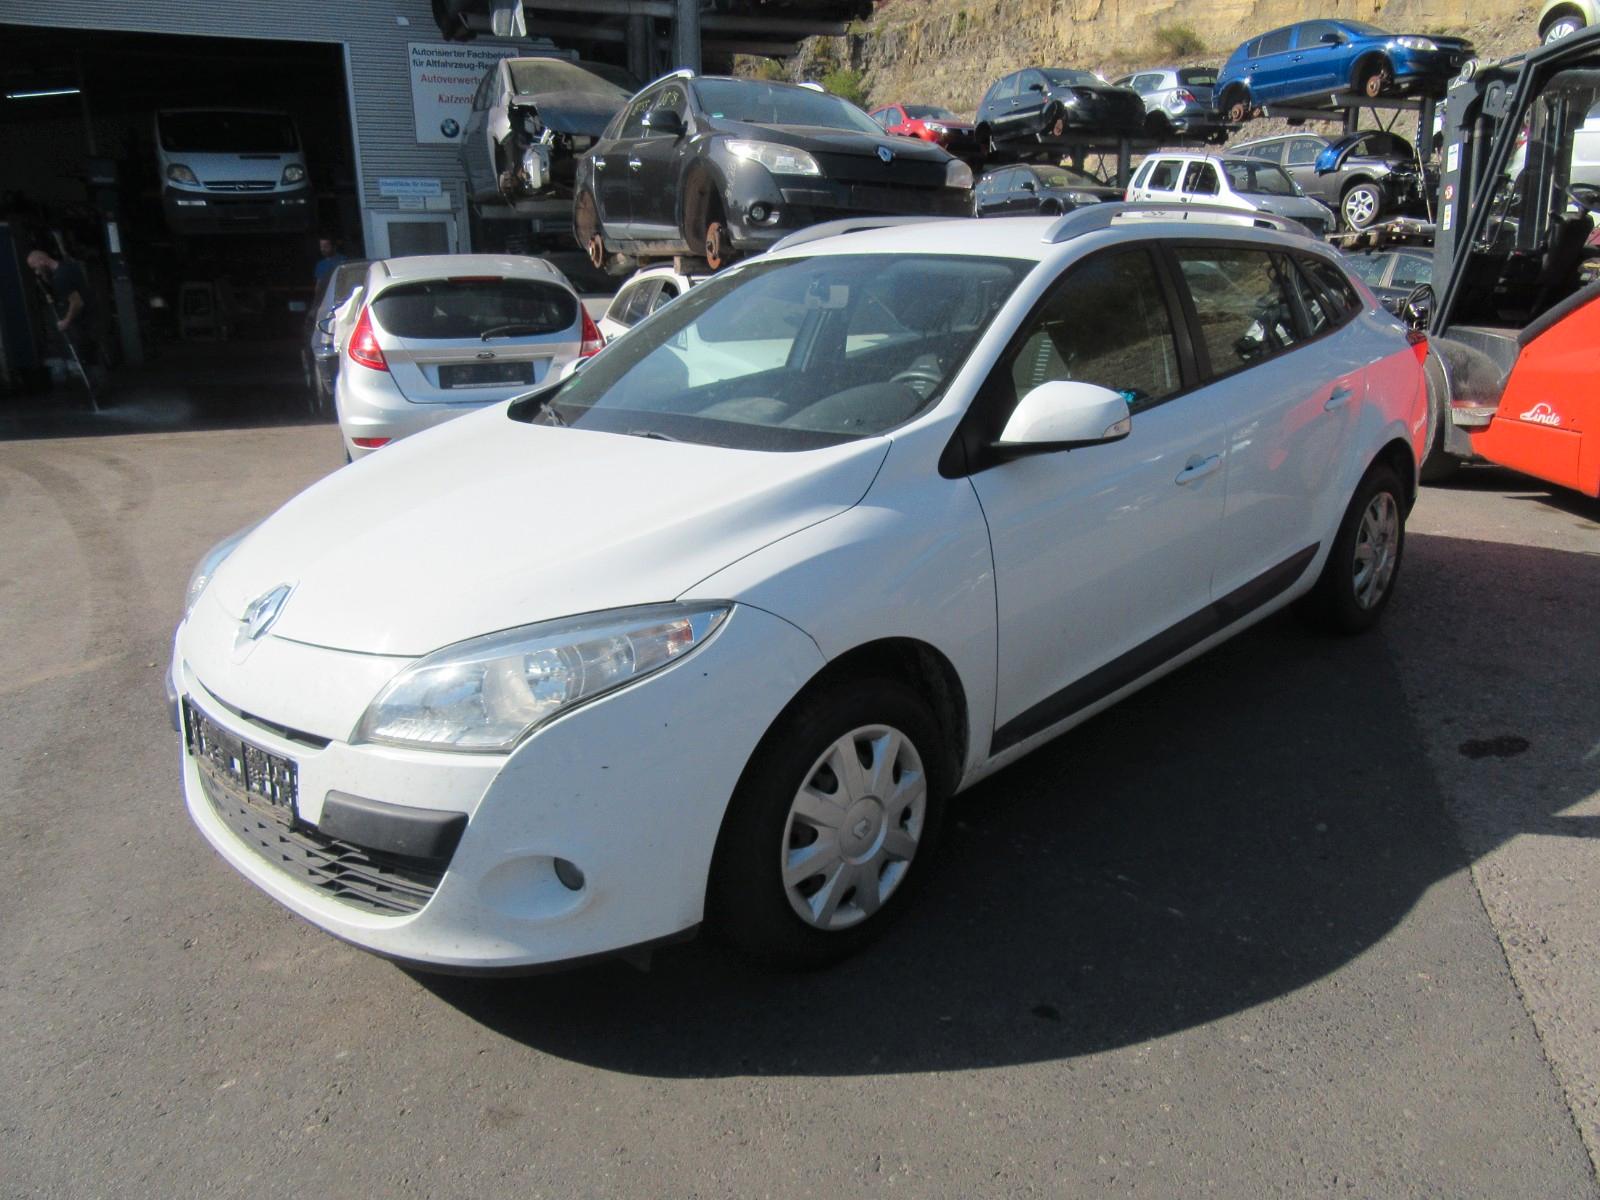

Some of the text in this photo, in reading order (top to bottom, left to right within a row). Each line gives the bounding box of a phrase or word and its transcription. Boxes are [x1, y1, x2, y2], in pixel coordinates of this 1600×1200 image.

[411, 47, 466, 58] Autorisierter
[412, 59, 424, 68] für
[1519, 402, 1561, 426] Linde
